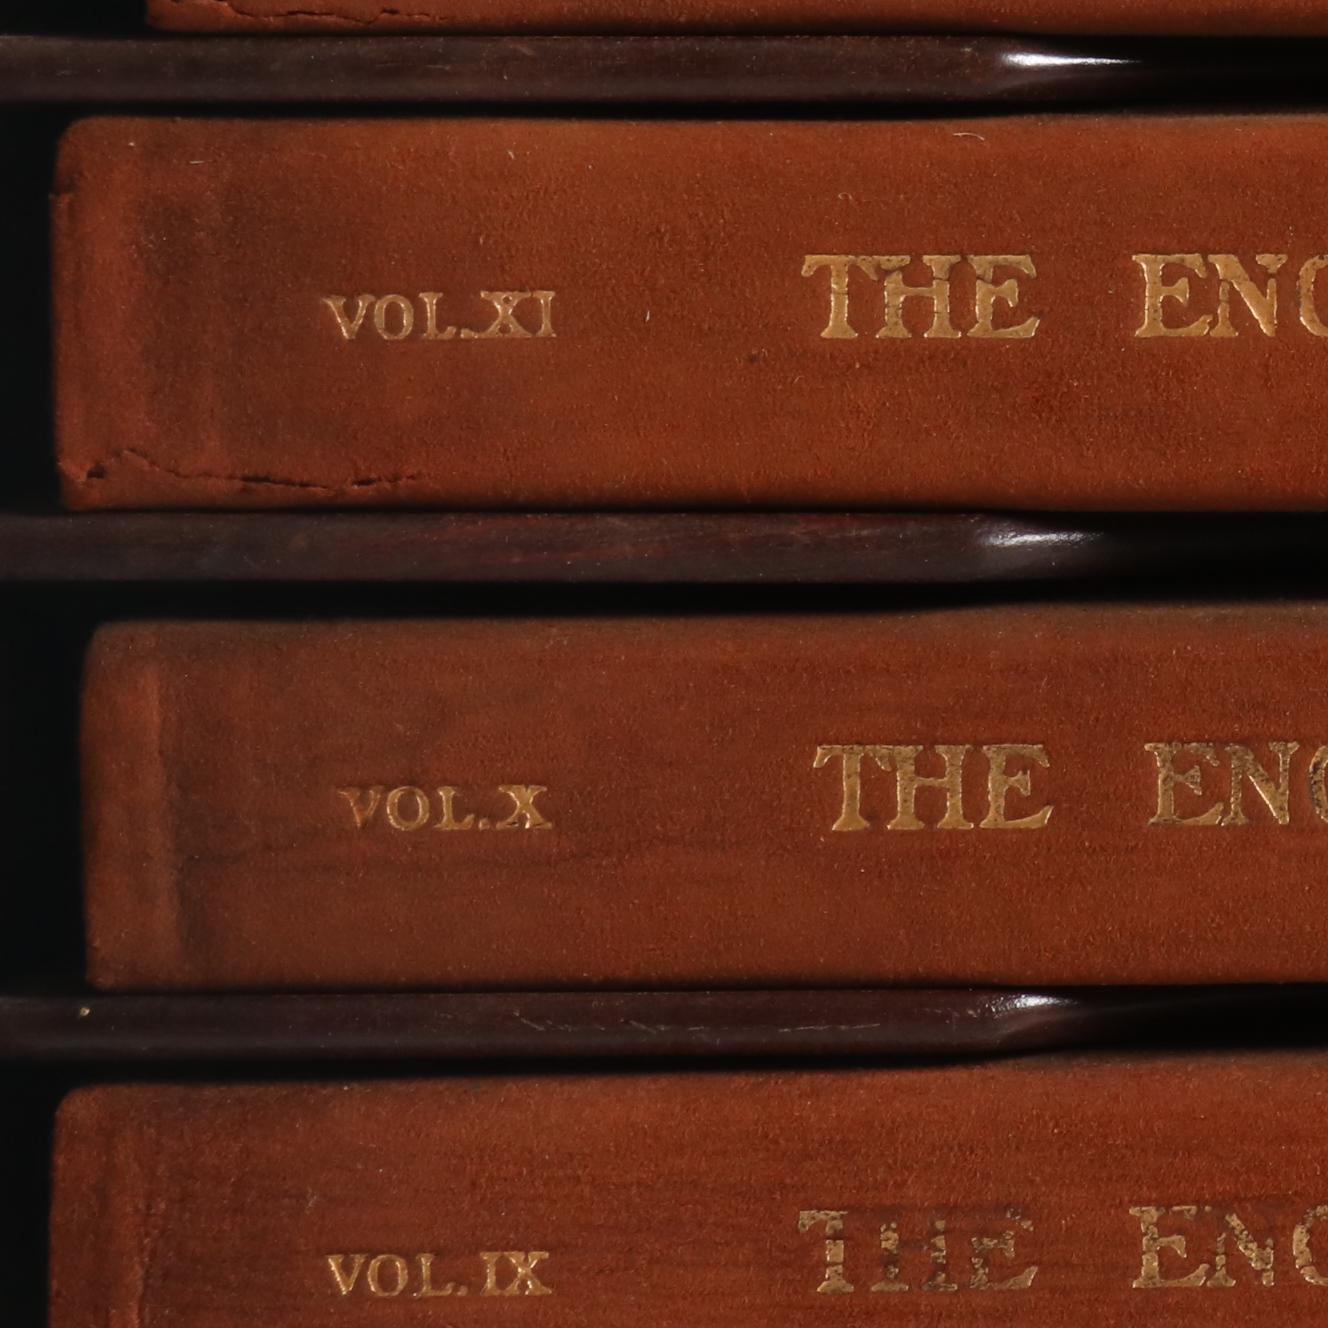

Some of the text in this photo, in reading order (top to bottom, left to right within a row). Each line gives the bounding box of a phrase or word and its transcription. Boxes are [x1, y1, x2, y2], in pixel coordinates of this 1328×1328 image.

[801, 253, 1042, 341] THE
[813, 742, 1054, 833] THE
[797, 1207, 1036, 1295] THE
